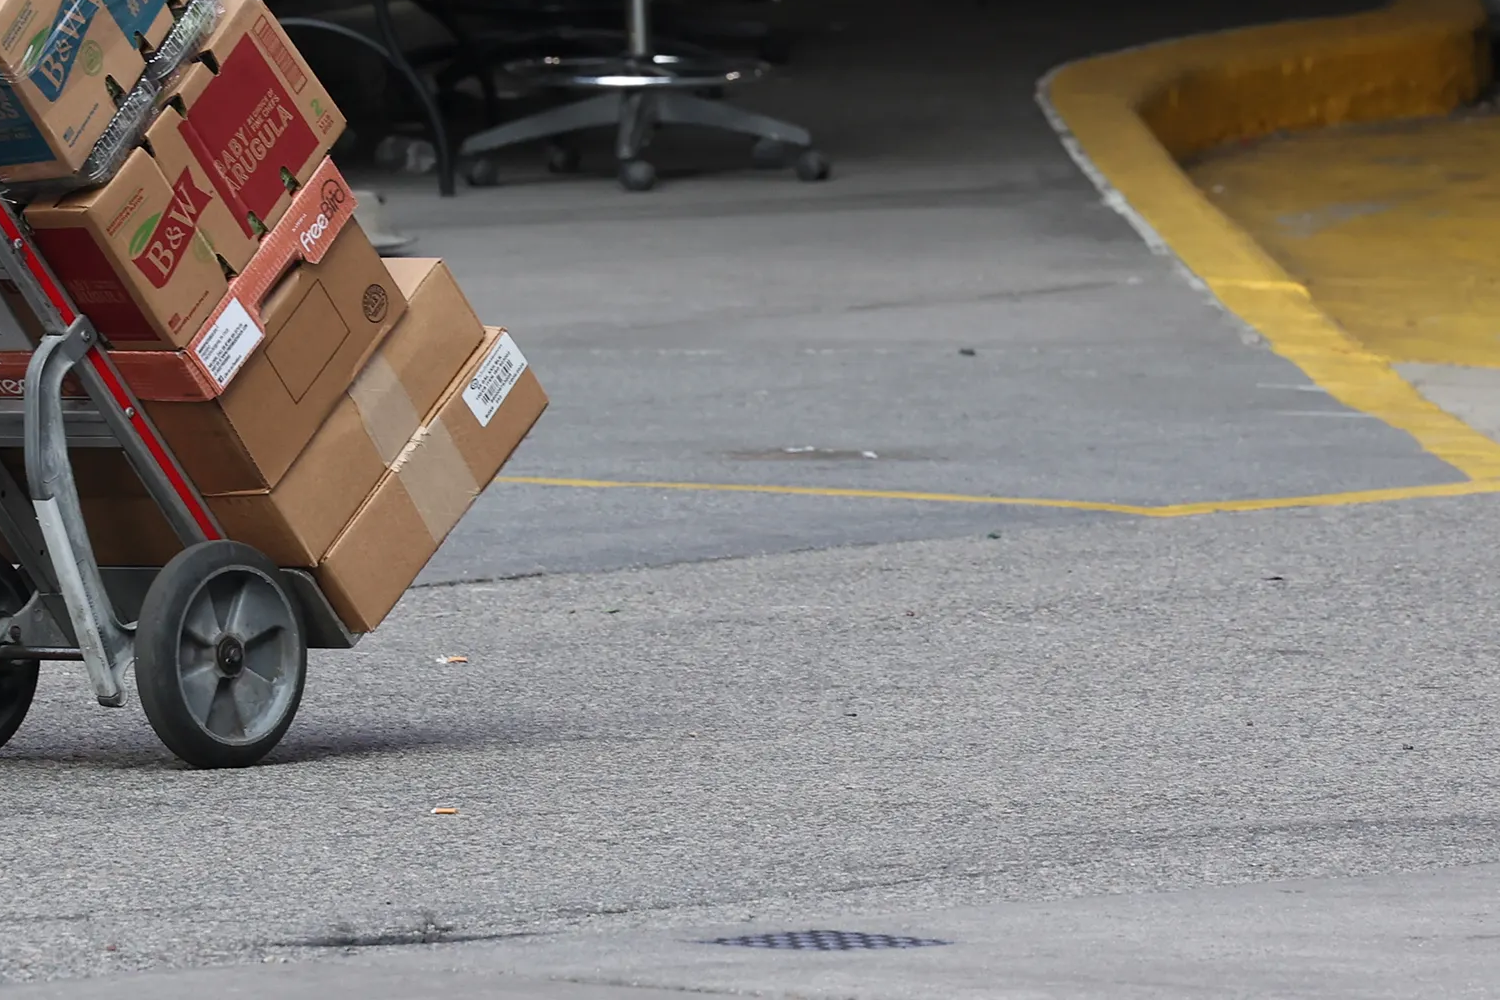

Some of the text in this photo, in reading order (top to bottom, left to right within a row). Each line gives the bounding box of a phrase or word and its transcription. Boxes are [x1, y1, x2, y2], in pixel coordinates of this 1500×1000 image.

[260, 93, 281, 118] CHEFS
[213, 126, 250, 175] BABY
[223, 104, 294, 199] ARUGULA
[145, 182, 198, 279] B&W
